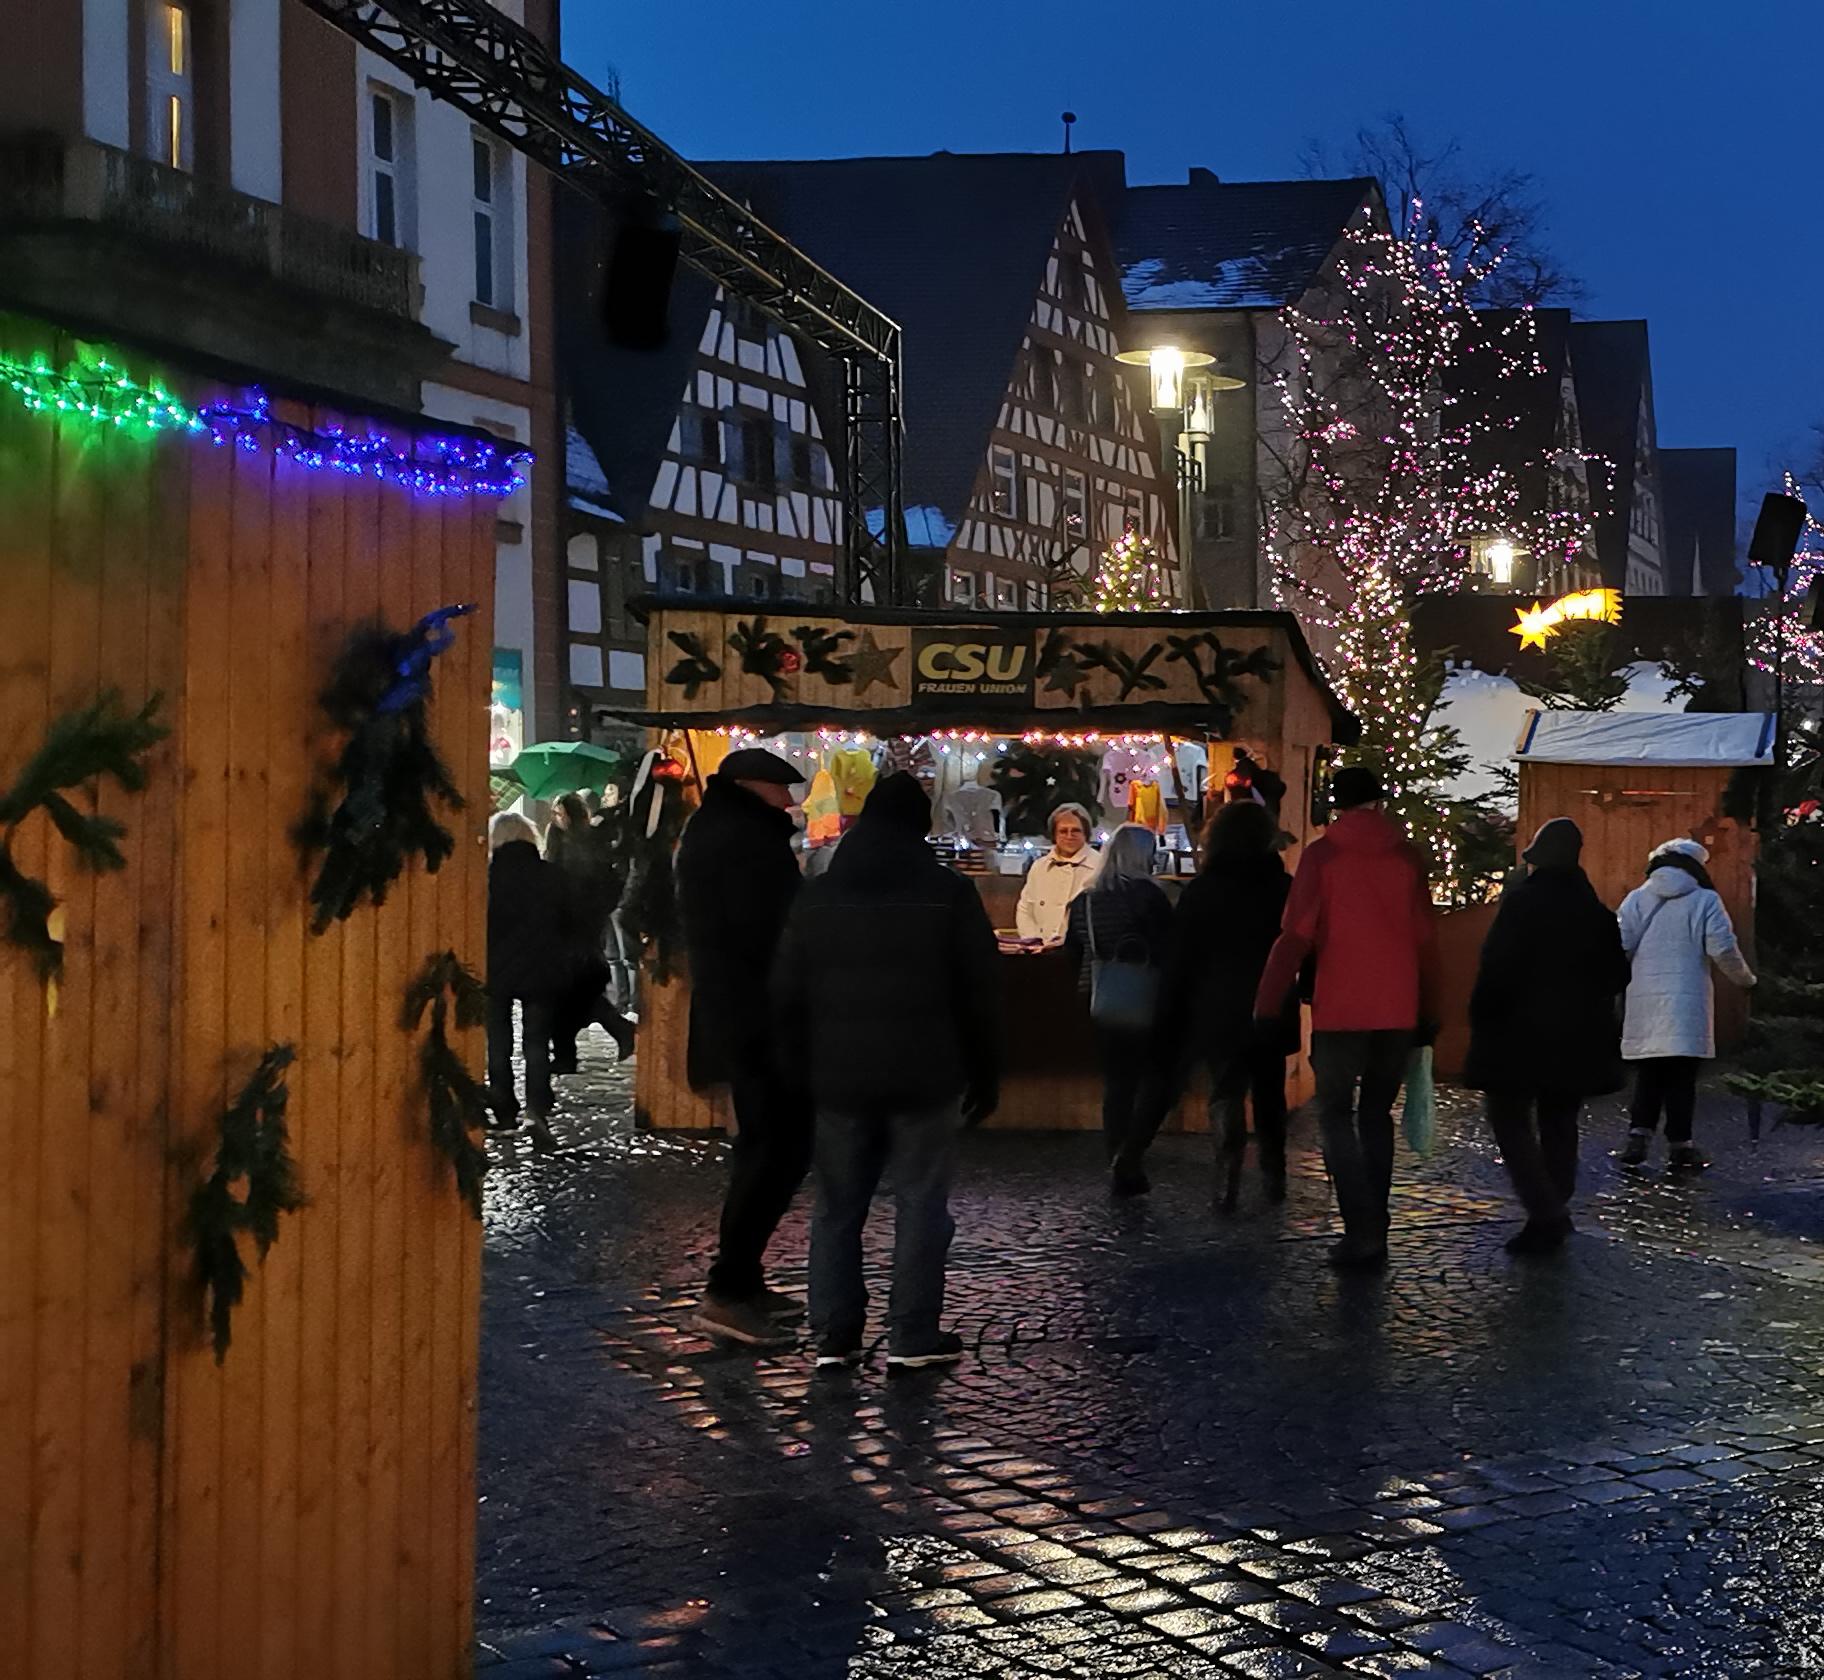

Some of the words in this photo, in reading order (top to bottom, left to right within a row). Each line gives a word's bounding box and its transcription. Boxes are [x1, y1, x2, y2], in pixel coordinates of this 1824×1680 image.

[918, 643, 1027, 680] CSU
[918, 682, 975, 694] FRAUEN
[979, 683, 1027, 694] UNION
